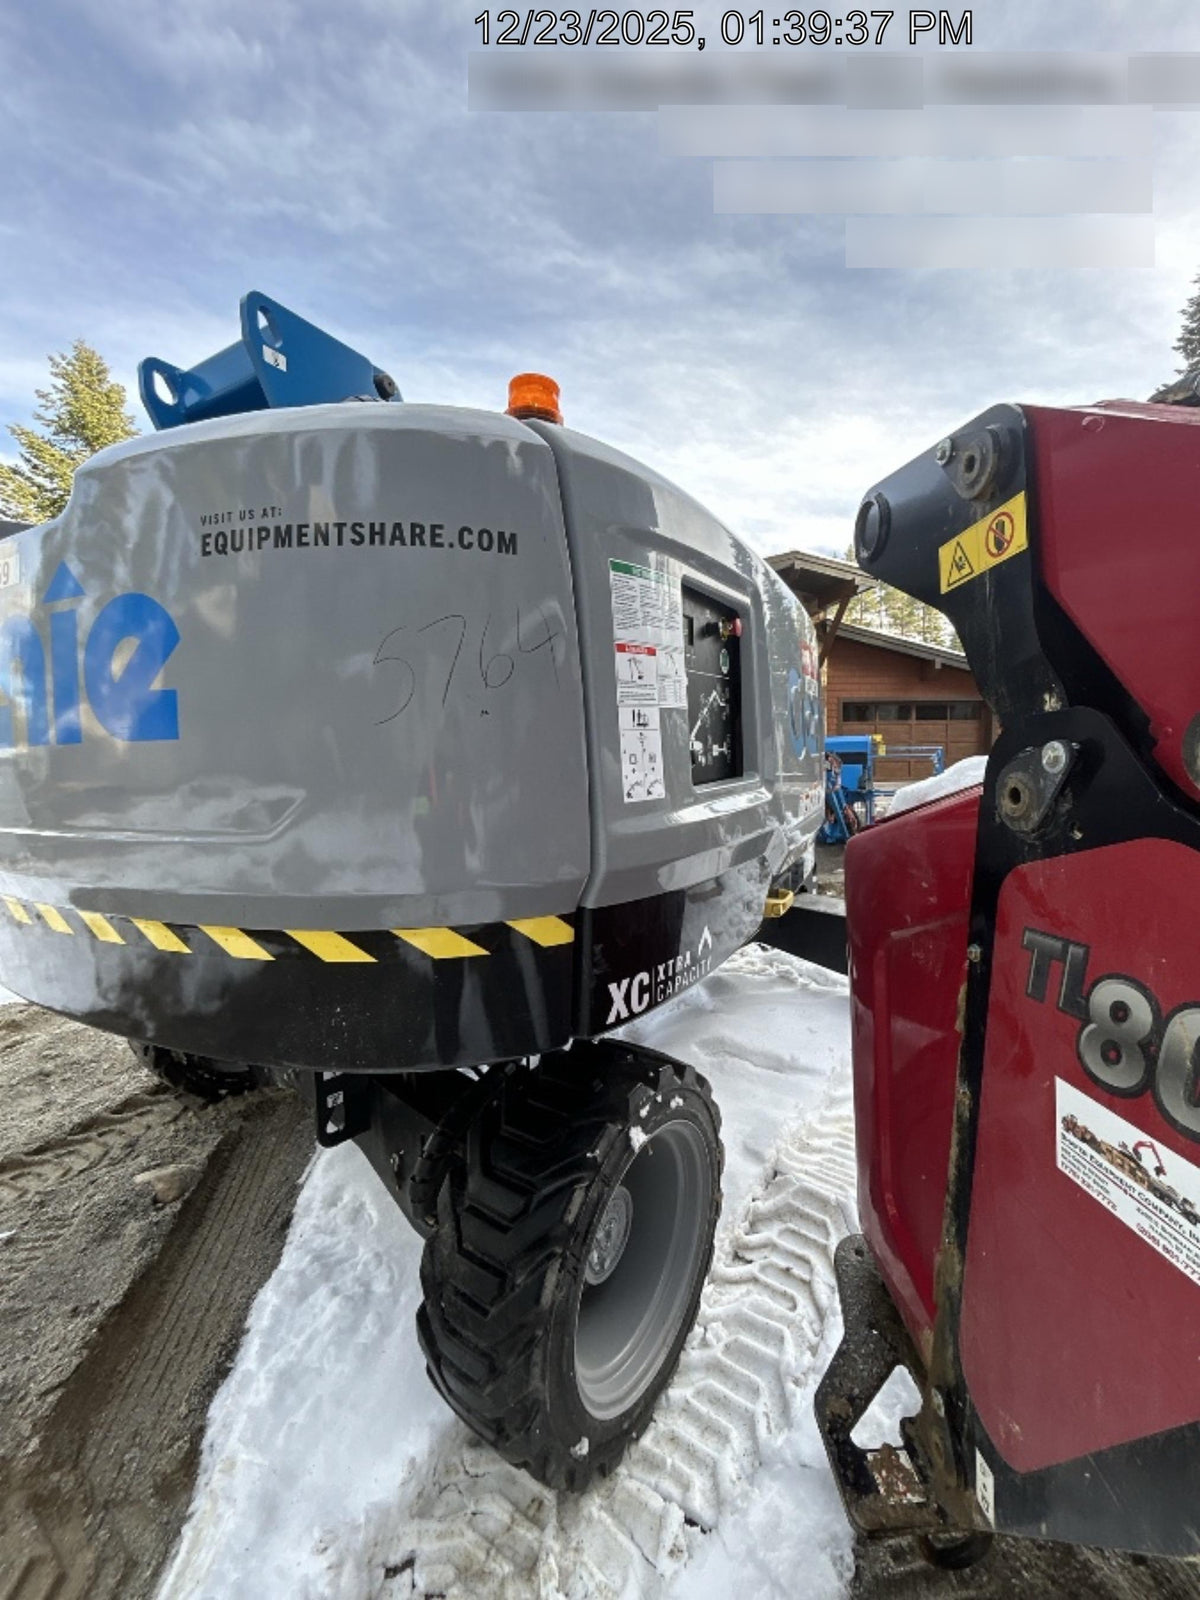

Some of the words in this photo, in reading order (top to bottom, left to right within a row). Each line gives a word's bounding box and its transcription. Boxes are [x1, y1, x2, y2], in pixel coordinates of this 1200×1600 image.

[200, 511, 233, 527] VISIT
[239, 508, 255, 522] US
[261, 505, 282, 519] AT:
[200, 521, 518, 556] EQUIPMENTSHARE.COM
[657, 950, 691, 982] XTRA
[657, 955, 712, 1002] CAPACITY
[606, 971, 650, 1025] XC
